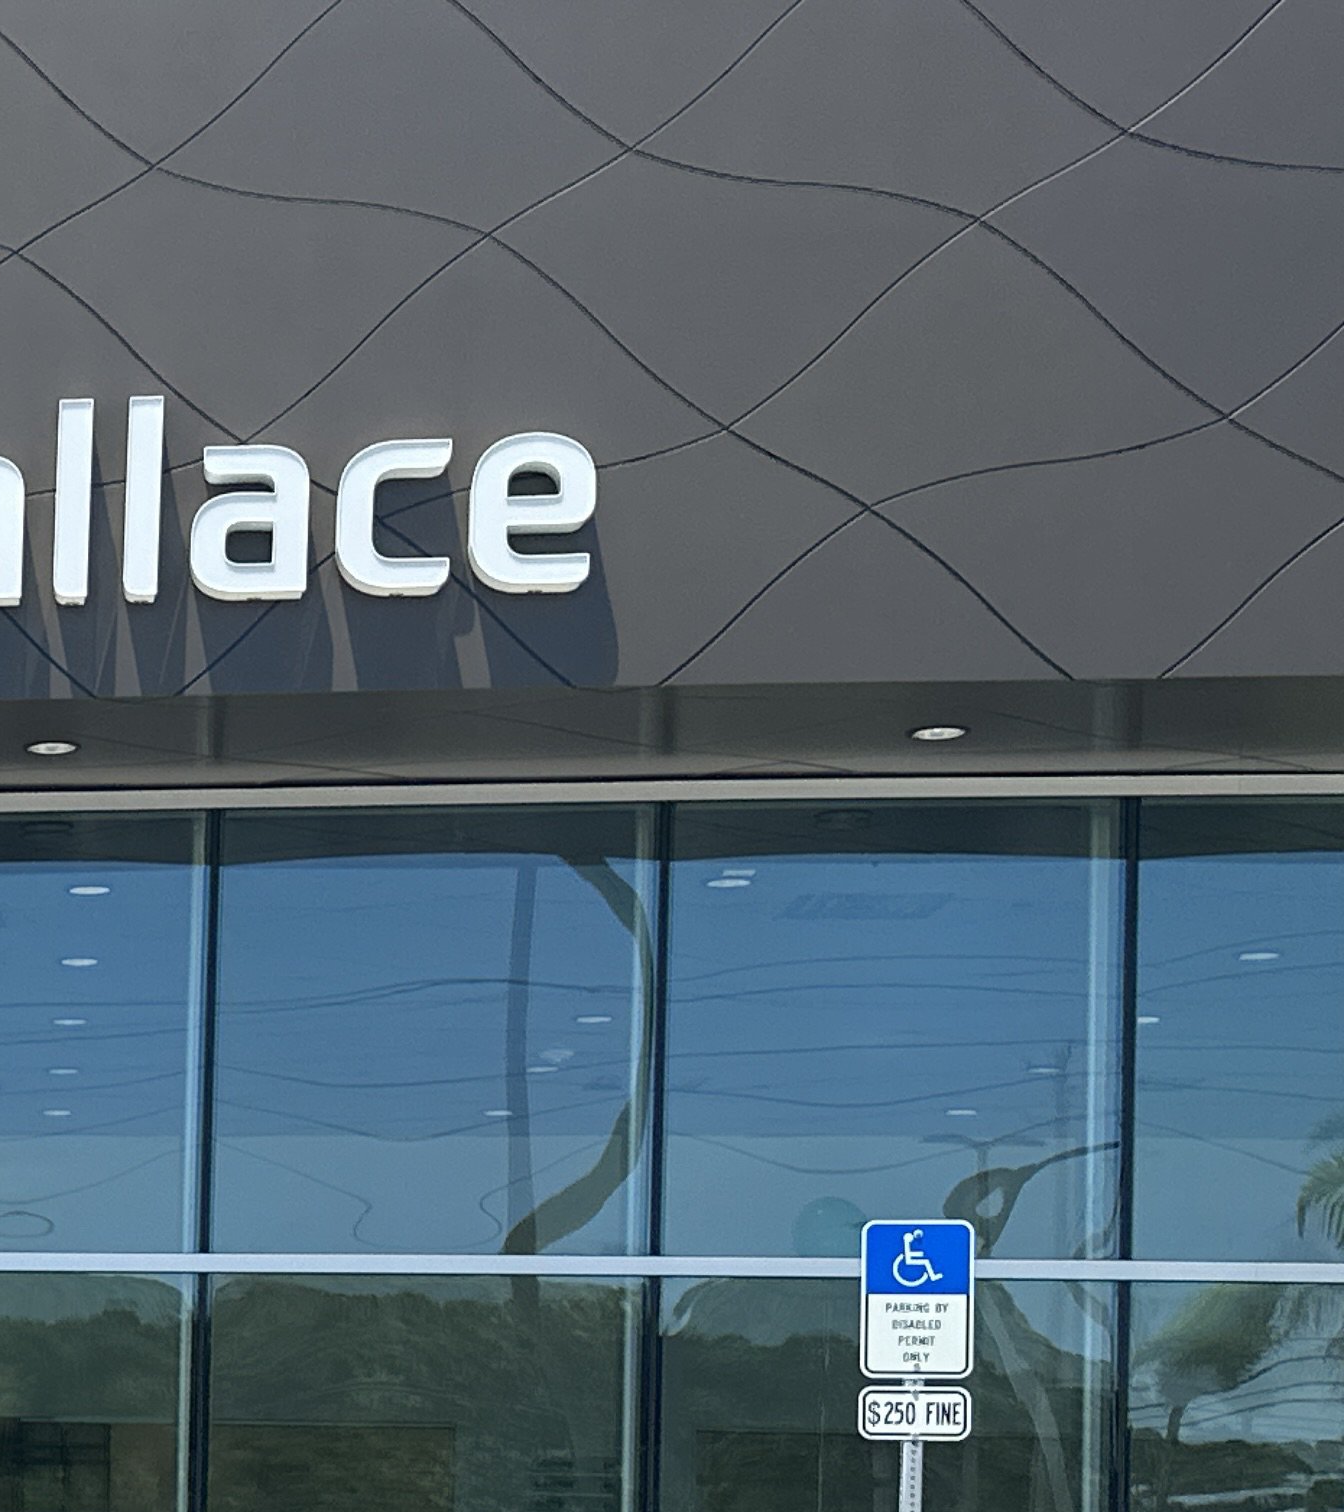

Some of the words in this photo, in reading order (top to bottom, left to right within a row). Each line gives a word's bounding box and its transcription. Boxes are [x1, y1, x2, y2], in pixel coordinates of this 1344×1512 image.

[885, 1302, 929, 1313] PARKING
[935, 1303, 948, 1313] BY
[892, 1319, 941, 1330] DISABLED
[898, 1335, 935, 1346] PERMIT
[902, 1351, 930, 1363] ONLY
[867, 1400, 916, 1427] $250
[926, 1402, 961, 1425] FINE
